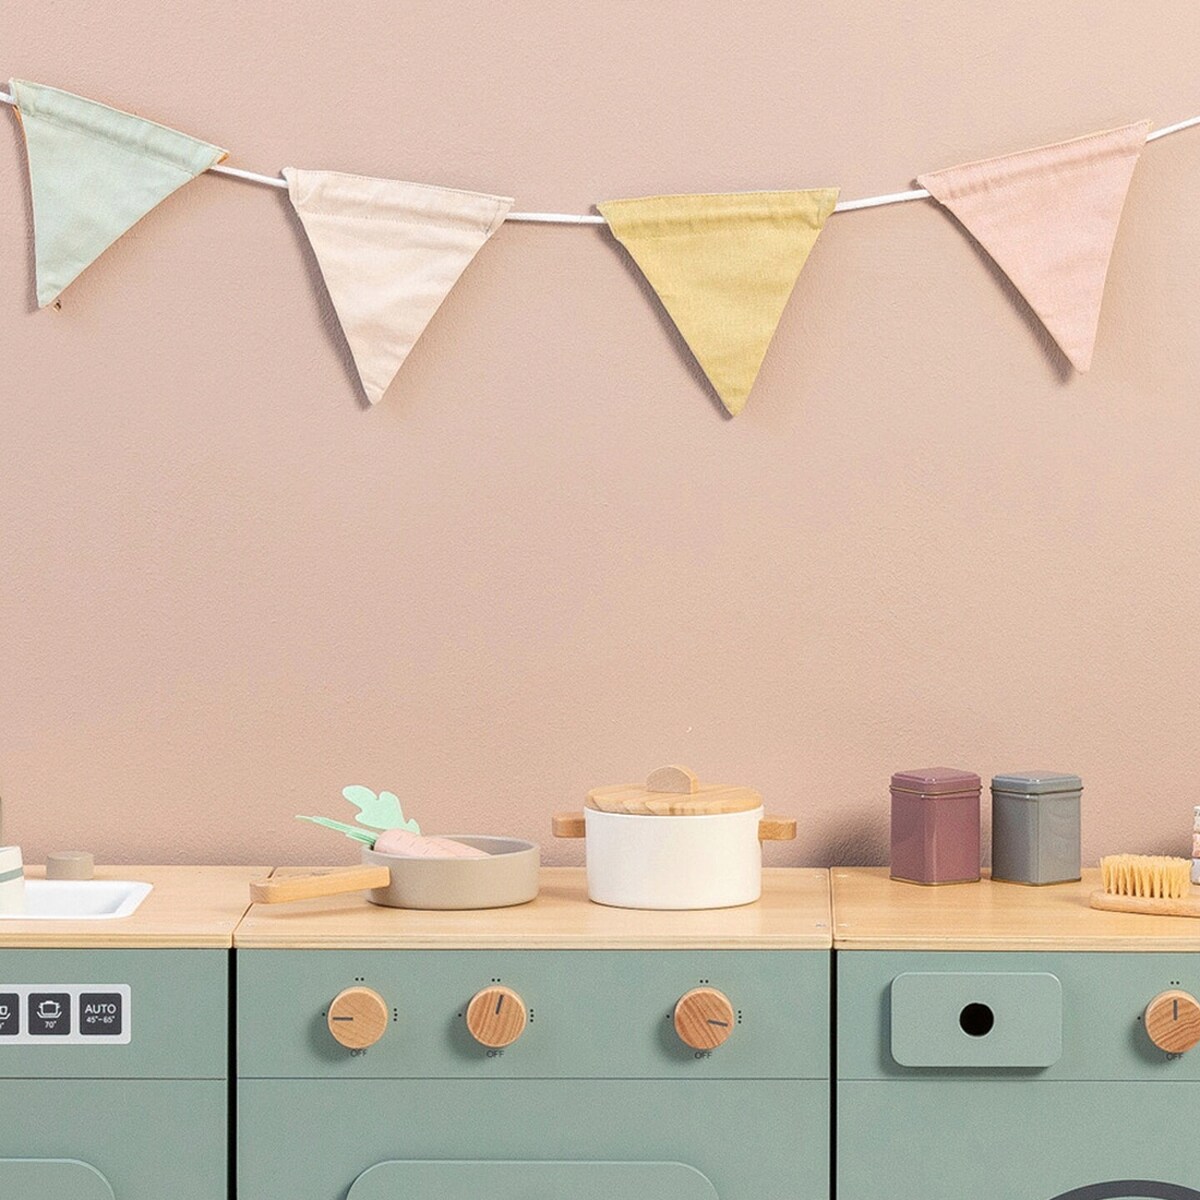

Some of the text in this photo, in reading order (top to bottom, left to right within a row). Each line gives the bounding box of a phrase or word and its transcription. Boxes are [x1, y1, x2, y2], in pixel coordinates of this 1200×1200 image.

[84, 1003, 117, 1014] AUTO
[350, 1048, 367, 1057] OFF
[486, 1050, 504, 1058] OFF
[695, 1051, 712, 1059] OFF
[1165, 1052, 1184, 1061] OFF
